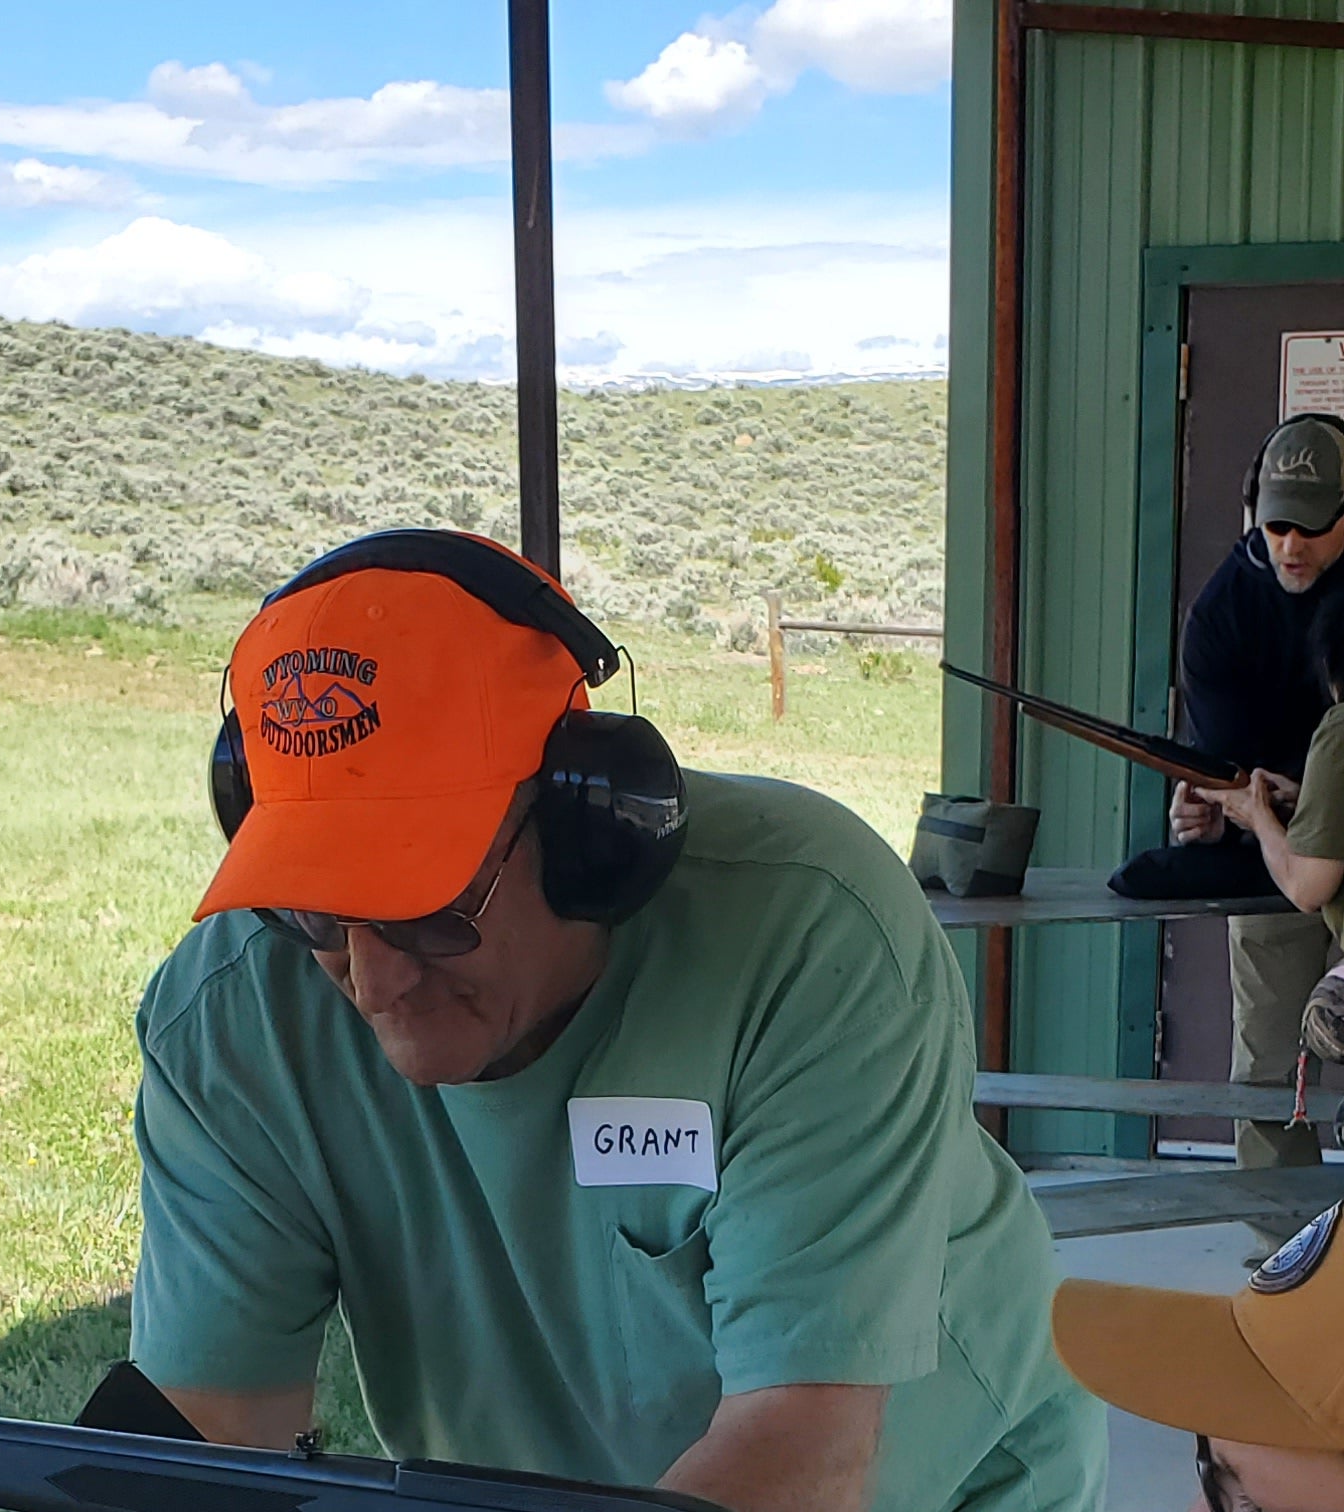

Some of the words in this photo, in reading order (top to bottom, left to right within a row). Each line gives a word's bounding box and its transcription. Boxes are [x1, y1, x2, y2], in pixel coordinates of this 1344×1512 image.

[262, 647, 379, 690] WYOMING
[260, 701, 382, 757] OUTDOORSMEN
[593, 1123, 699, 1156] GRANT
